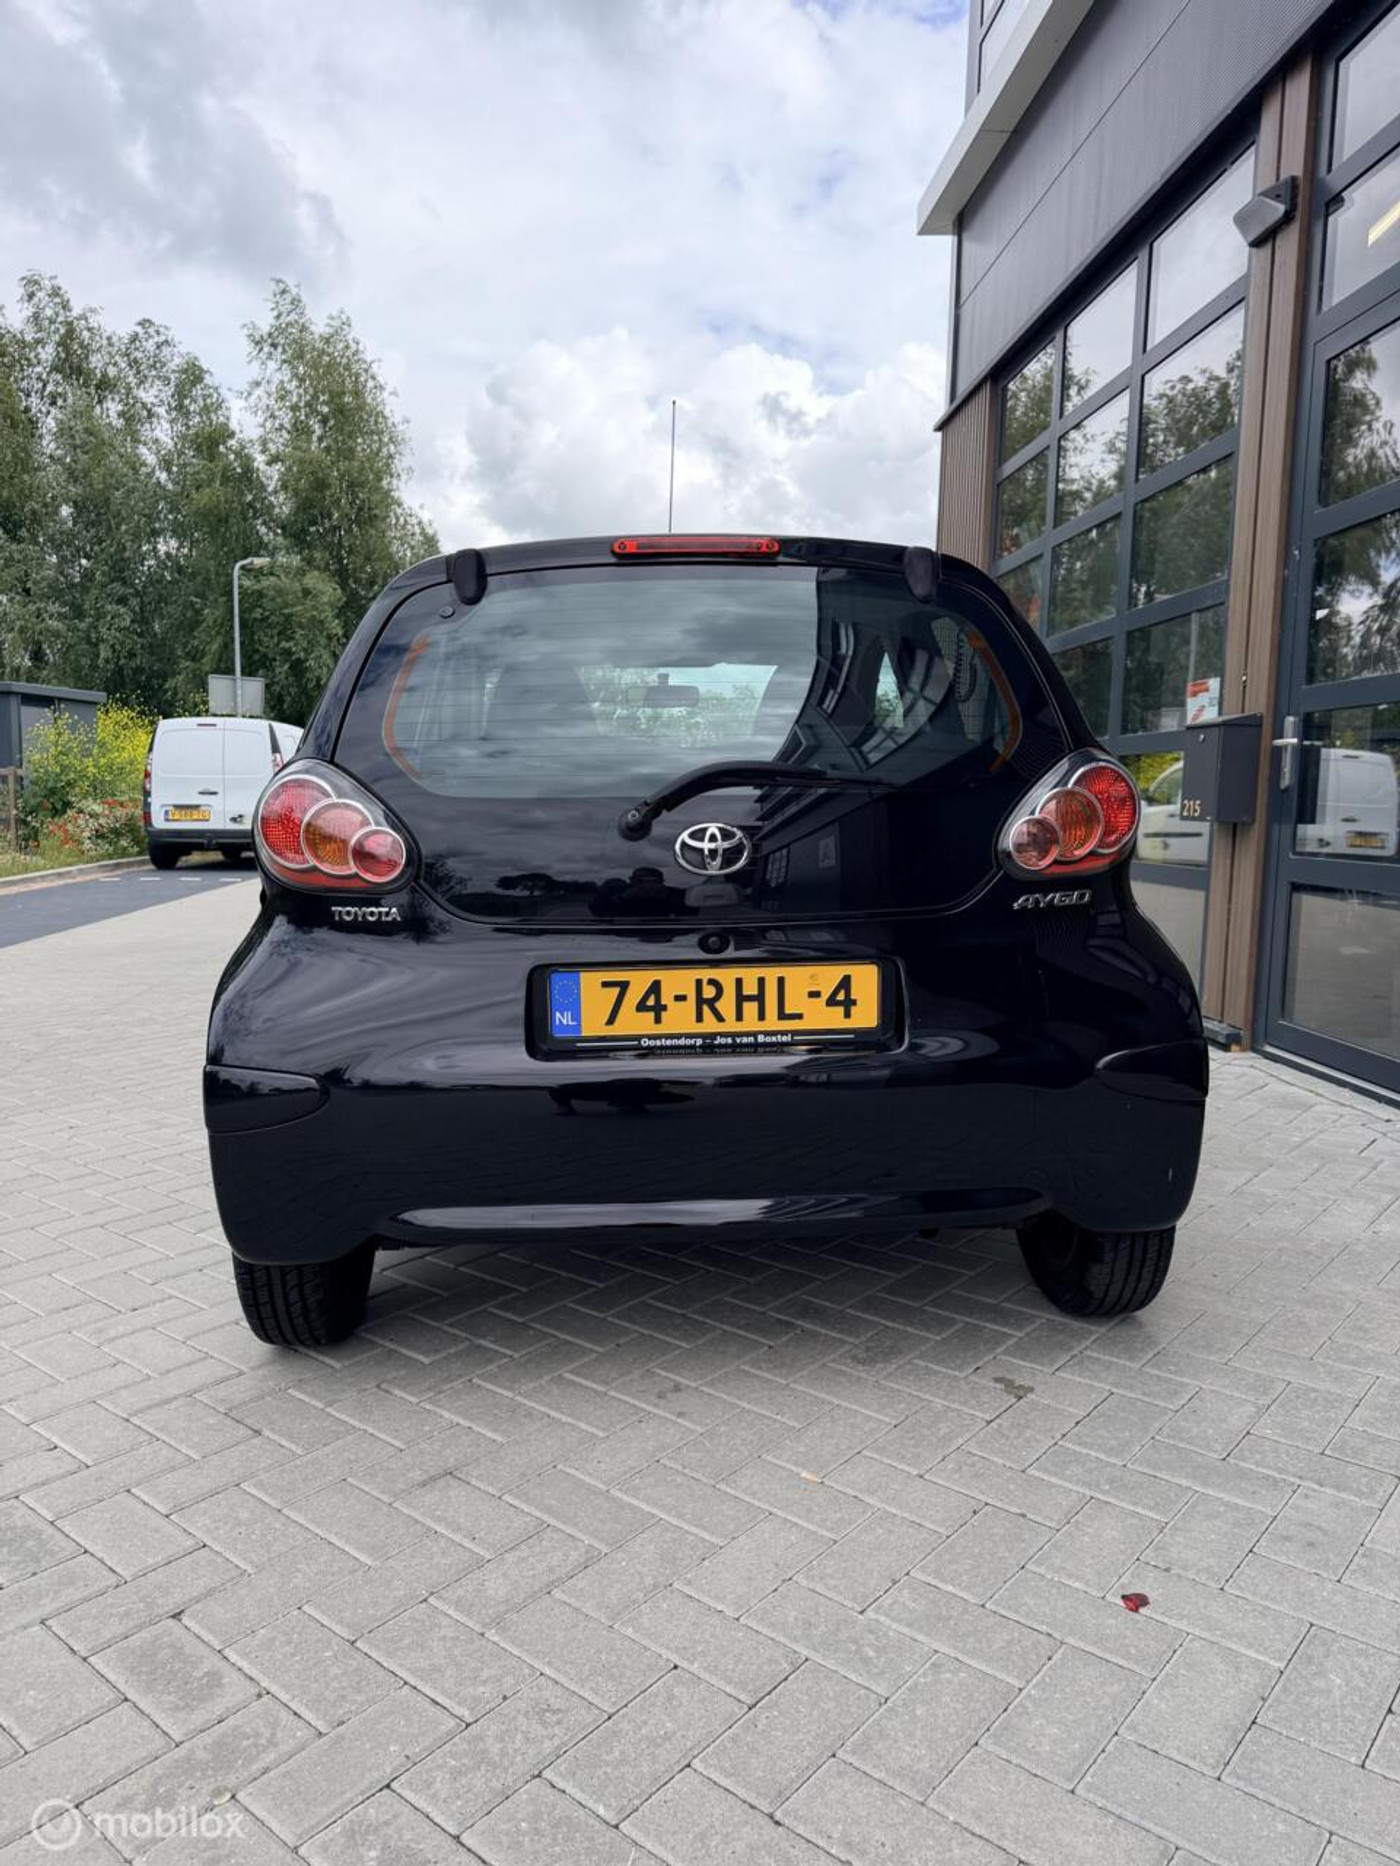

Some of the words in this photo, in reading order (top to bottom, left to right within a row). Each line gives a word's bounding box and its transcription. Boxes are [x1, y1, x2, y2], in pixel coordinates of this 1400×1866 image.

[1182, 799, 1201, 817] 215
[1012, 889, 1092, 910] AYGO
[331, 906, 401, 921] TOYOTA
[601, 974, 857, 1026] 74-RHL-4
[555, 1011, 577, 1026] NL
[641, 1037, 703, 1047] Oostendorp
[713, 1036, 732, 1045] Jos
[735, 1036, 754, 1044] van
[758, 1034, 792, 1043] Boxtel
